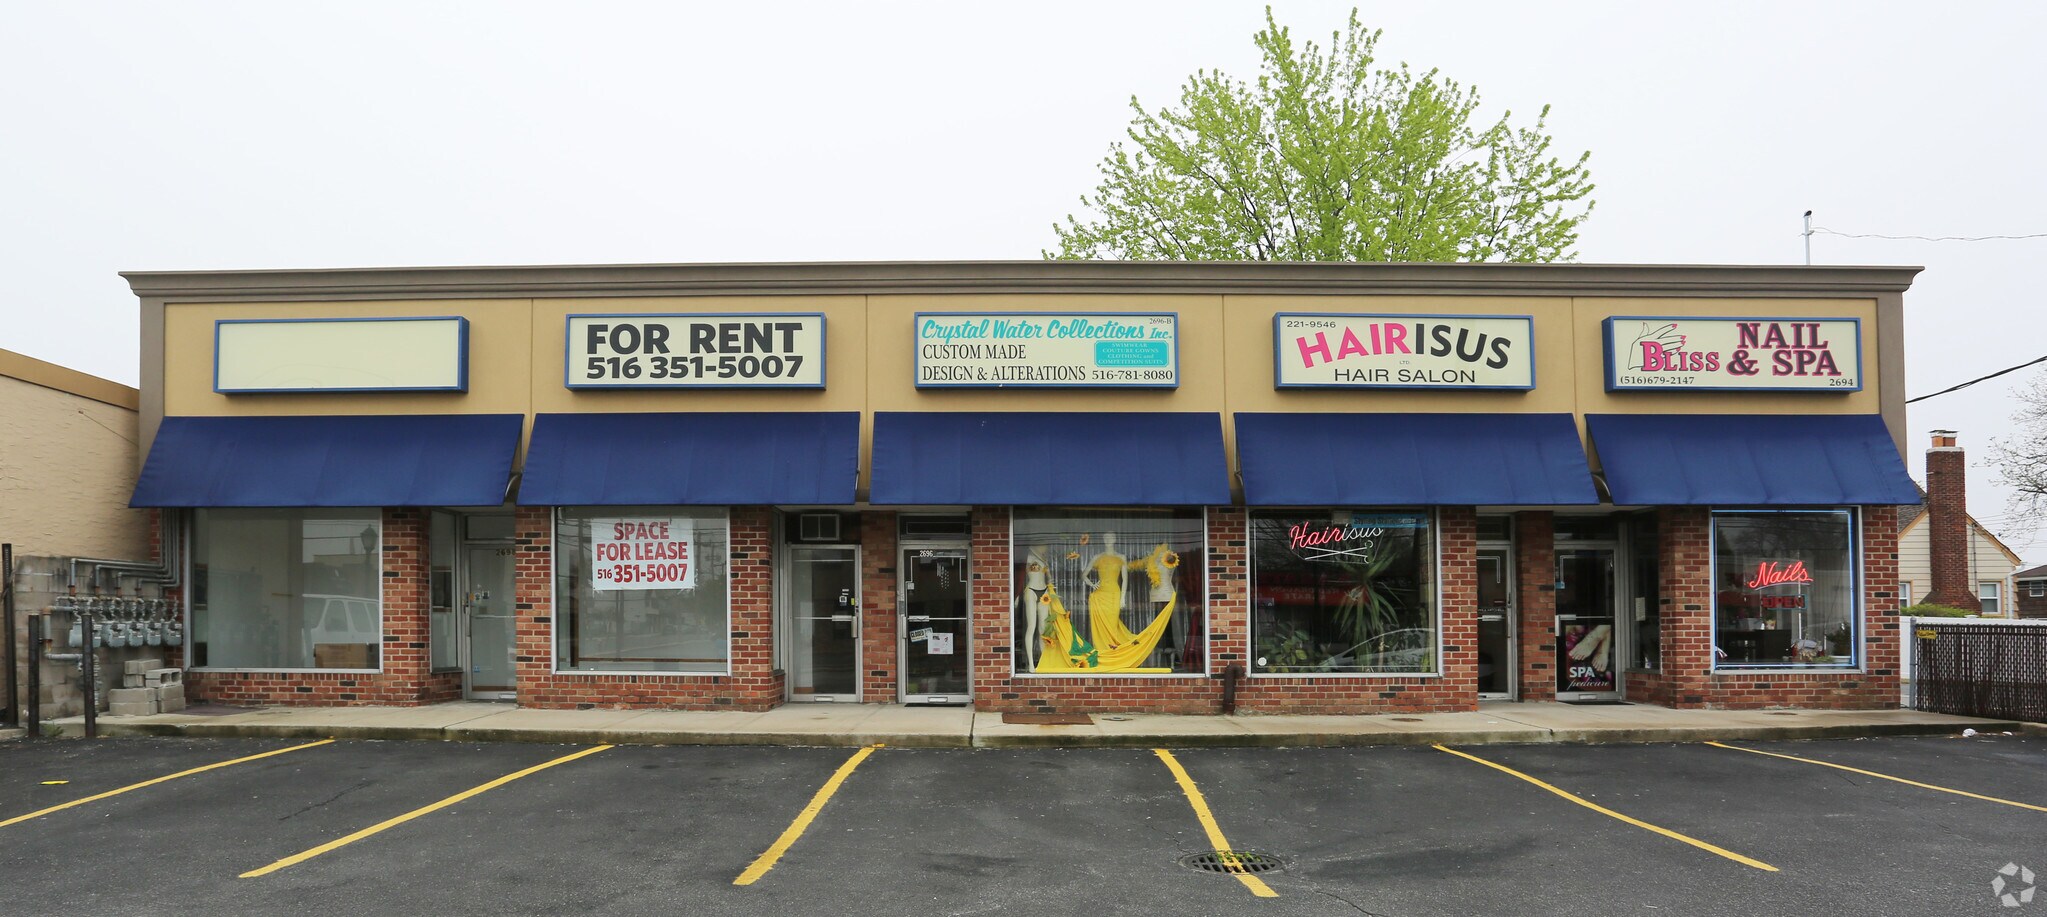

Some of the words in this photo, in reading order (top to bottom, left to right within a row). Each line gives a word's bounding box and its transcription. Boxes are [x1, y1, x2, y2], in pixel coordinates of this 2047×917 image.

[921, 318, 991, 345] Crystal
[992, 319, 1045, 339] Water
[1046, 318, 1145, 339] Collections
[1149, 327, 1173, 339] Inc.
[1286, 320, 1337, 329] 221-9546
[587, 323, 670, 354] FOR
[690, 322, 803, 354] RENT
[1296, 322, 1512, 370] HAIRISUS
[1736, 322, 1829, 350] NAIL
[922, 344, 982, 360] CUSTOM
[985, 344, 1027, 360] MADE
[586, 356, 642, 379] 516
[649, 355, 804, 379] 351-5007
[1726, 349, 1759, 376] &
[1772, 349, 1842, 376] SPA
[922, 365, 974, 381] DESIGN
[977, 366, 988, 381] &
[991, 365, 1086, 381] ALTERATIONS
[1091, 370, 1173, 380] 516-781-8080
[1334, 368, 1389, 383] HAIR
[1397, 369, 1476, 384] SALON
[1620, 376, 1695, 385] (516)679-2147
[1829, 378, 1854, 387] 2694
[613, 521, 670, 541] SPACE
[1290, 521, 1384, 550] Hairisus
[596, 543, 631, 561] FOR
[635, 541, 688, 561] LEASE
[597, 569, 613, 579] 516
[613, 563, 688, 583] 351-5007
[1749, 561, 1814, 589] Nails
[1761, 596, 1805, 608] OPEN
[1569, 666, 1596, 678] SPA
[1566, 677, 1610, 691] pedicure
